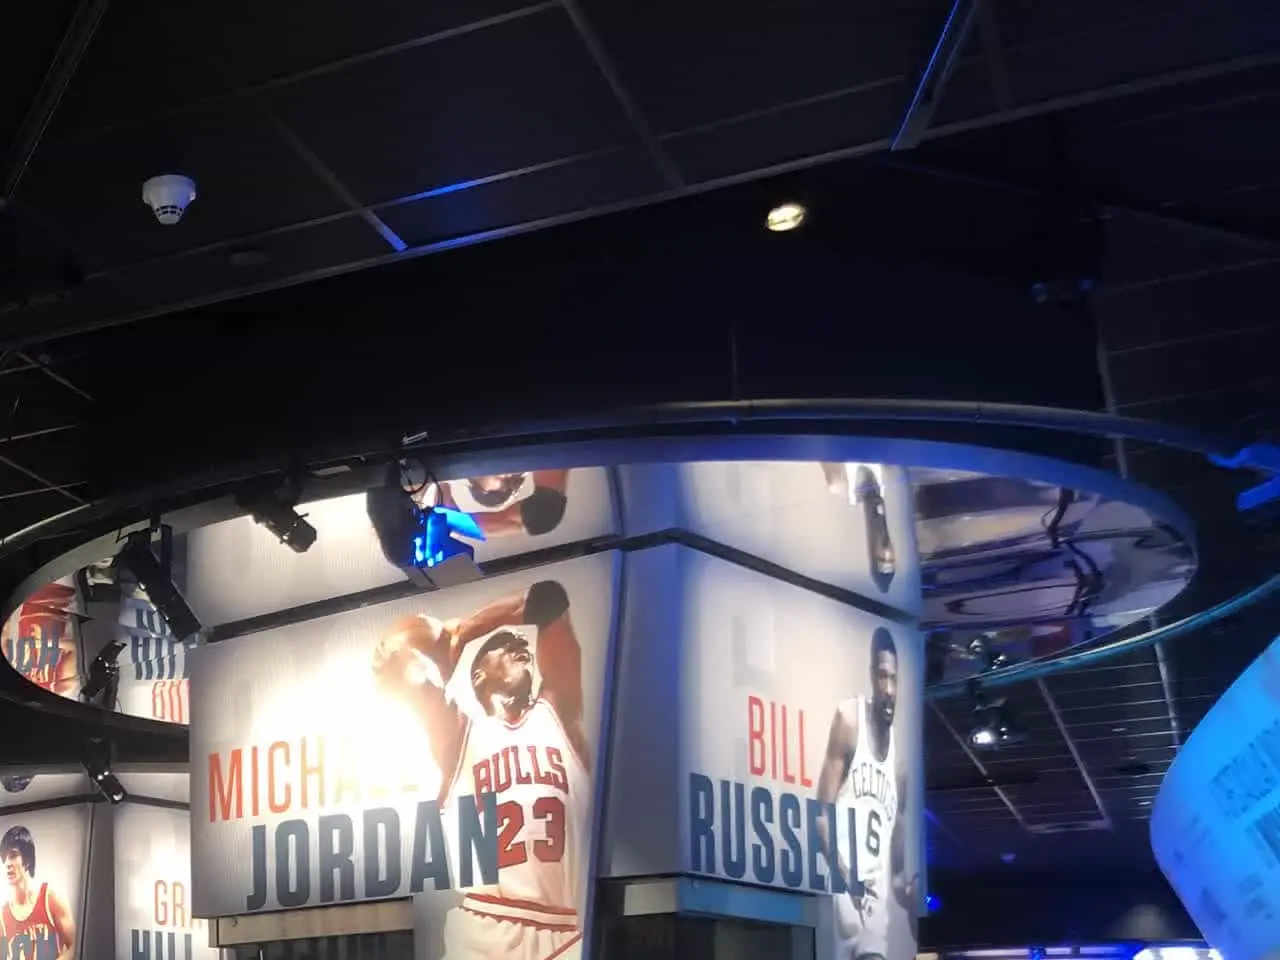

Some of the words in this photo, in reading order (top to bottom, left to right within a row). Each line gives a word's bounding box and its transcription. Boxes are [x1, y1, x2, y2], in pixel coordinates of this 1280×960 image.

[472, 745, 569, 814] BULLS
[748, 696, 812, 788] BILL
[246, 792, 500, 911] JORDAN
[496, 796, 566, 870] 23
[688, 773, 865, 897] RUSSELL
[865, 809, 883, 858] 6
